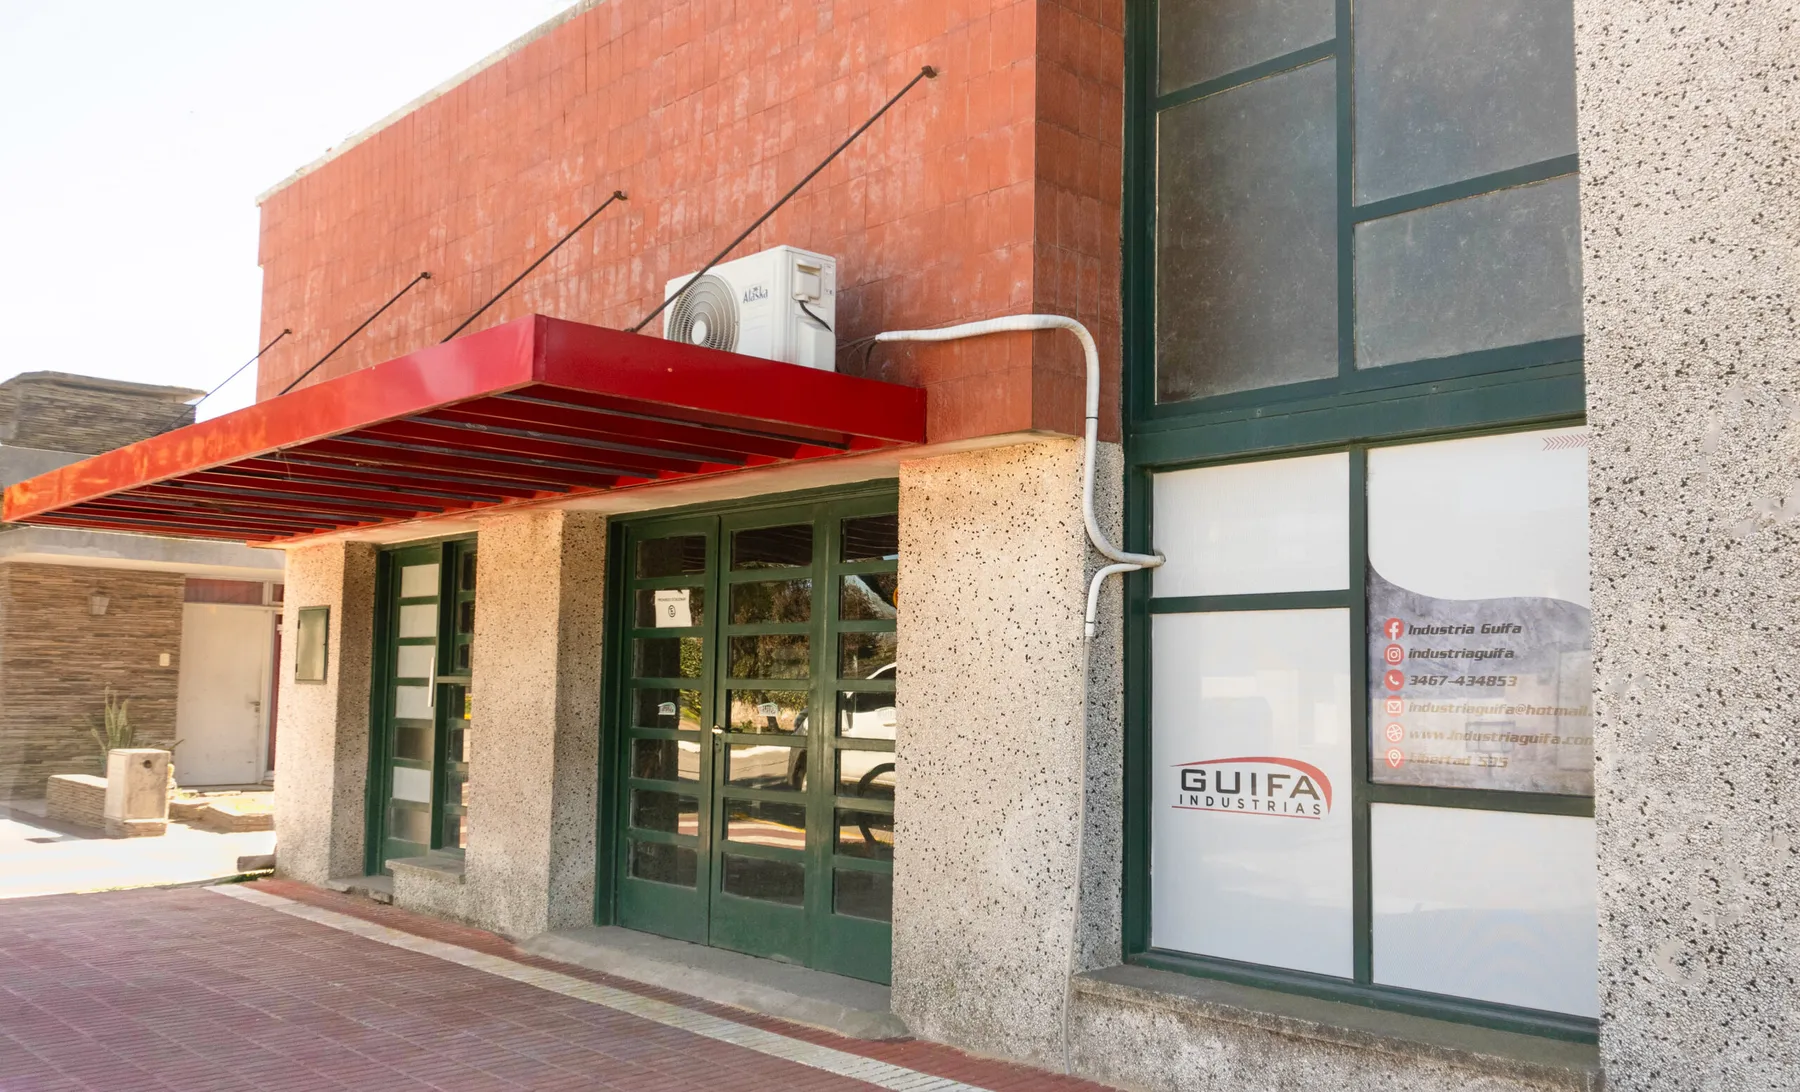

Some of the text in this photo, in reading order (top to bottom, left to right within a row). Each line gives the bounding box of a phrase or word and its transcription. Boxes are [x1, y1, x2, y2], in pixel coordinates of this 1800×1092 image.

[743, 285, 768, 303] Alaska
[1408, 623, 1522, 635] Industria Guifa
[1408, 648, 1515, 661] industriaguifa
[1408, 675, 1518, 687] 3467-434853
[1181, 768, 1321, 800] GUIFA
[1179, 794, 1321, 815] INDUSTRIAS
